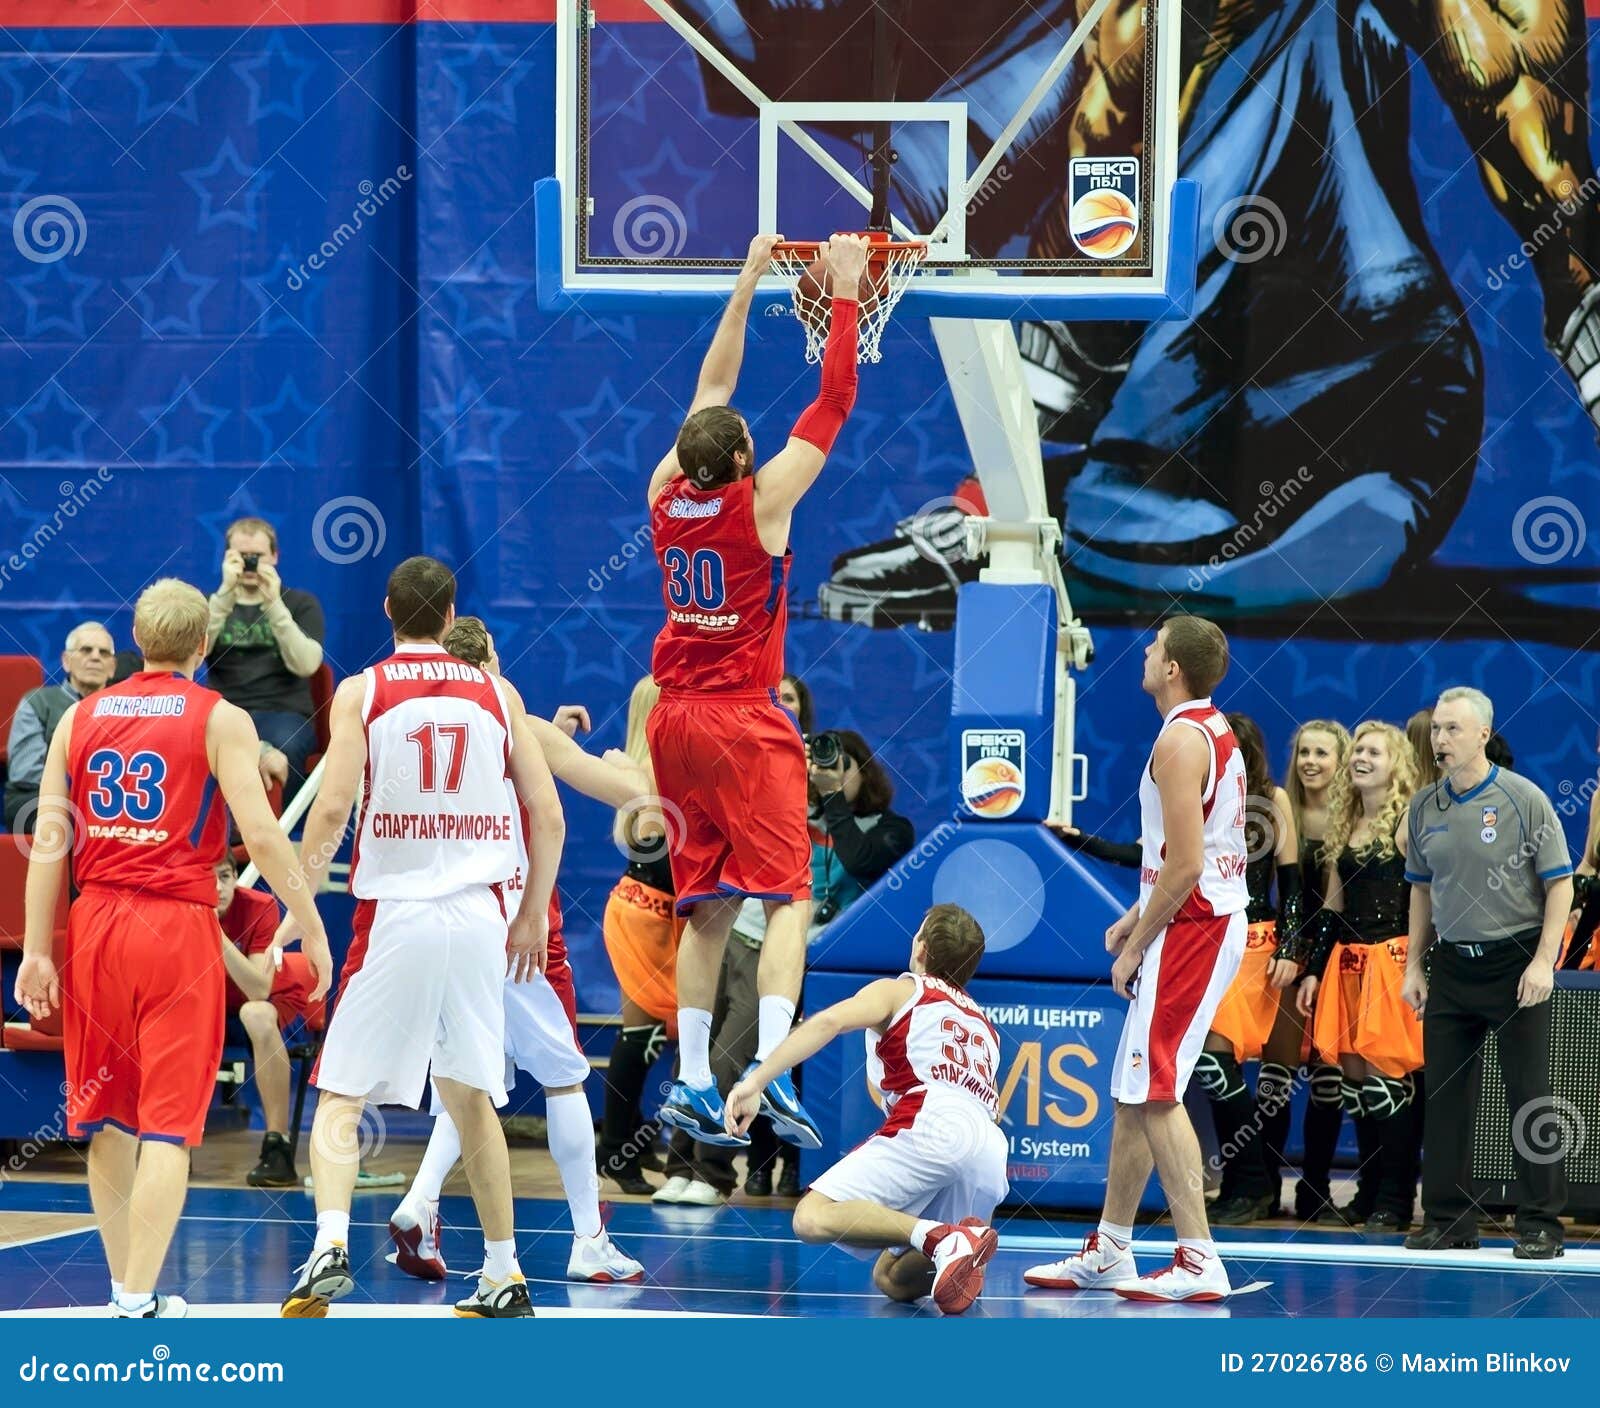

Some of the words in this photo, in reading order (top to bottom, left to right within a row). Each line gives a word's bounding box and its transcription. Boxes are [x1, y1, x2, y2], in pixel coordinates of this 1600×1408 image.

[1074, 162, 1135, 176] BEKO
[1090, 176, 1122, 189] ПБЛ
[664, 545, 726, 611] 30
[382, 661, 486, 685] КАРАУЛОВ
[94, 694, 186, 718] ПОНКРАШОВ
[405, 721, 469, 794] 17
[980, 746, 1009, 758] ПБЛ
[87, 747, 168, 823] 33
[372, 813, 511, 841] СПАРТАК-ПРИМОРЬЕ
[1033, 1008, 1102, 1030] ЦЕНТР
[1020, 1137, 1090, 1159] System
